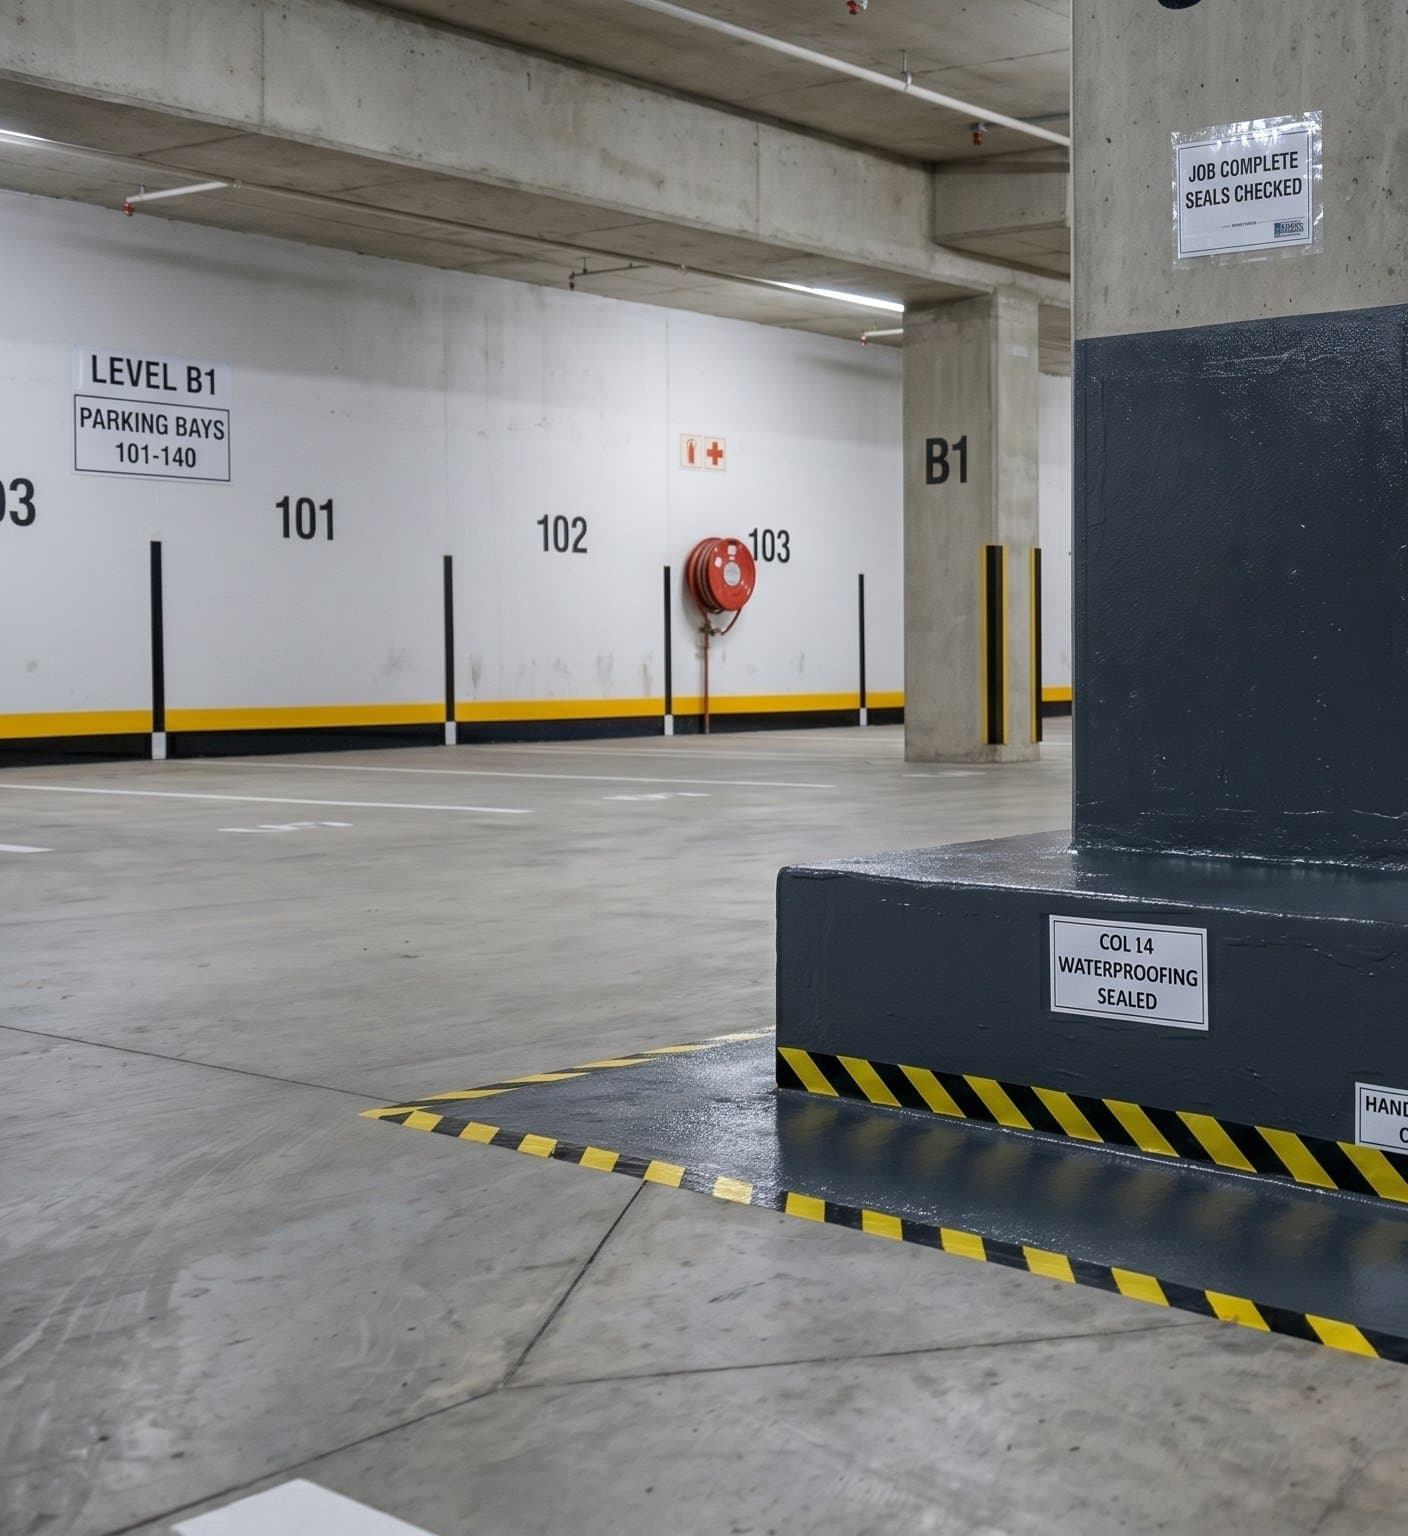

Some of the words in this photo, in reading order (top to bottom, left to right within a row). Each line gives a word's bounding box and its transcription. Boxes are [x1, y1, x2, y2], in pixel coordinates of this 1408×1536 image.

[1189, 163, 1215, 182] JOB
[1220, 151, 1298, 177] COMPLETE
[1186, 187, 1229, 208] SEALS
[1235, 178, 1301, 202] CHECKED
[92, 355, 177, 391] LEVEL
[187, 366, 214, 395] B1
[81, 408, 168, 435] PARKING
[176, 417, 224, 440] BAYS
[116, 443, 196, 467] 101-140
[926, 436, 967, 484] B1
[0, 478, 35, 526] 3
[276, 496, 333, 540] 101
[538, 515, 587, 553] 102
[749, 528, 790, 565] 103
[1100, 934, 1131, 952] COL
[1136, 937, 1153, 954] 14
[1059, 956, 1198, 986] WATERPROOFING
[1098, 988, 1157, 1009] SEALED
